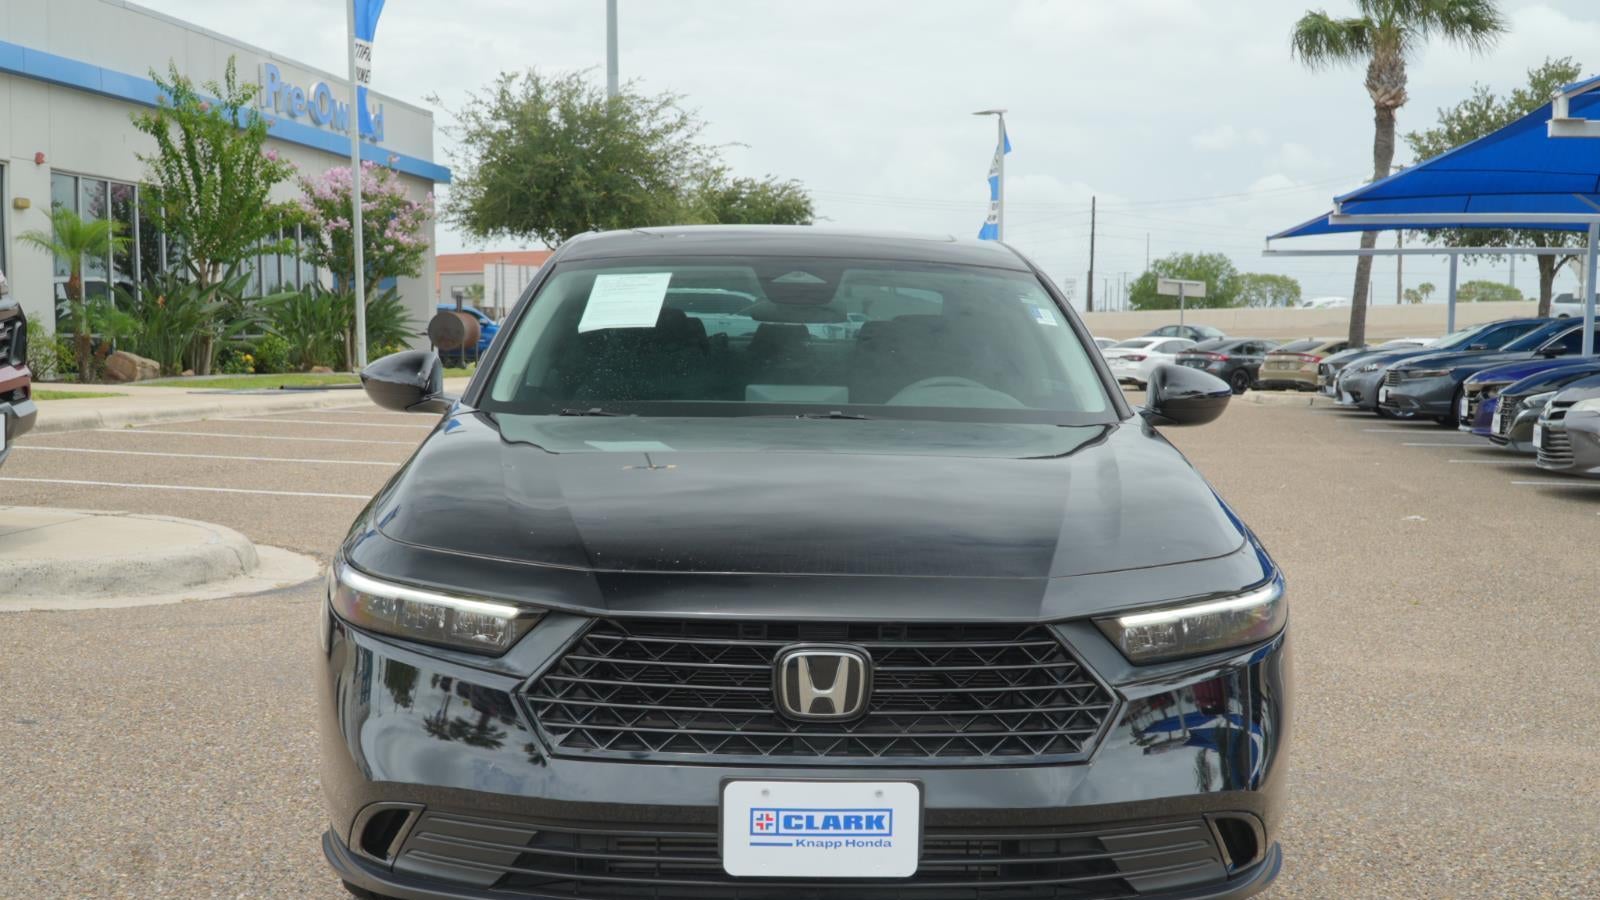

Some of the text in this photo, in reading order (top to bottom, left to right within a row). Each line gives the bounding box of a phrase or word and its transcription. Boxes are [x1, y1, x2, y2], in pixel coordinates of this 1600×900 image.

[260, 63, 384, 141] Pre-Owd
[783, 814, 886, 830] CLARK
[795, 839, 892, 849] Knapp Honda
